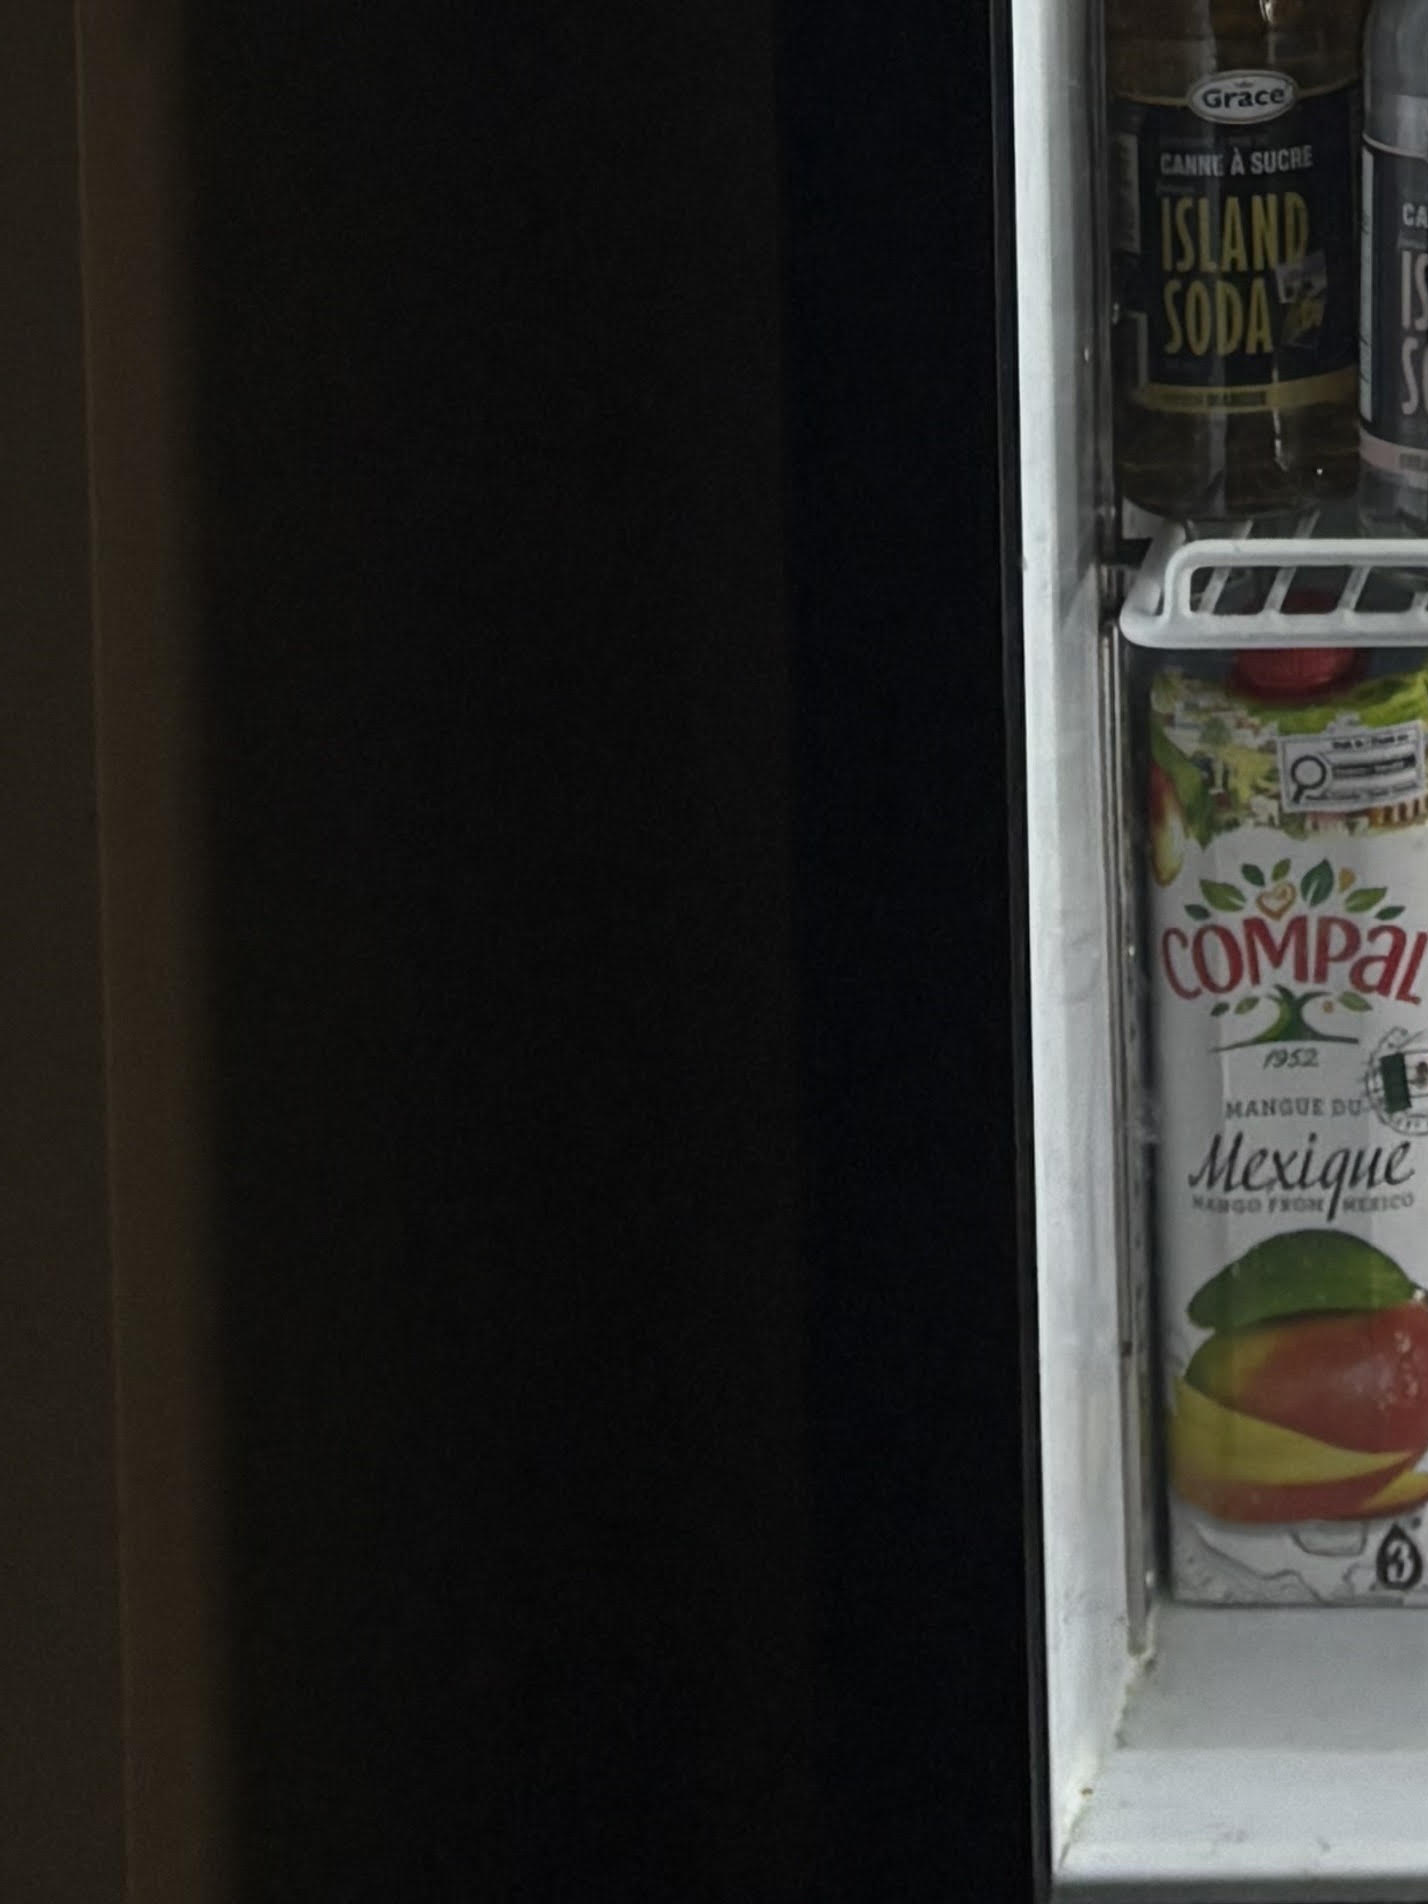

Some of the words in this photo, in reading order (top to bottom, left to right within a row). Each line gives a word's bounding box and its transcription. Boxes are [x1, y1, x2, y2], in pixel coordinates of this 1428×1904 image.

[1202, 87, 1286, 110] Grace
[1159, 152, 1226, 178] CANNE
[1229, 146, 1246, 176] À
[1249, 143, 1314, 176] SUCRE
[1159, 191, 1310, 274] ISLAND
[1162, 276, 1275, 357] SODA
[1262, 1047, 1320, 1070] 1952
[1225, 1097, 1324, 1120] MANGUE
[1330, 1097, 1363, 1118] DU
[1187, 1130, 1416, 1223] Mexique
